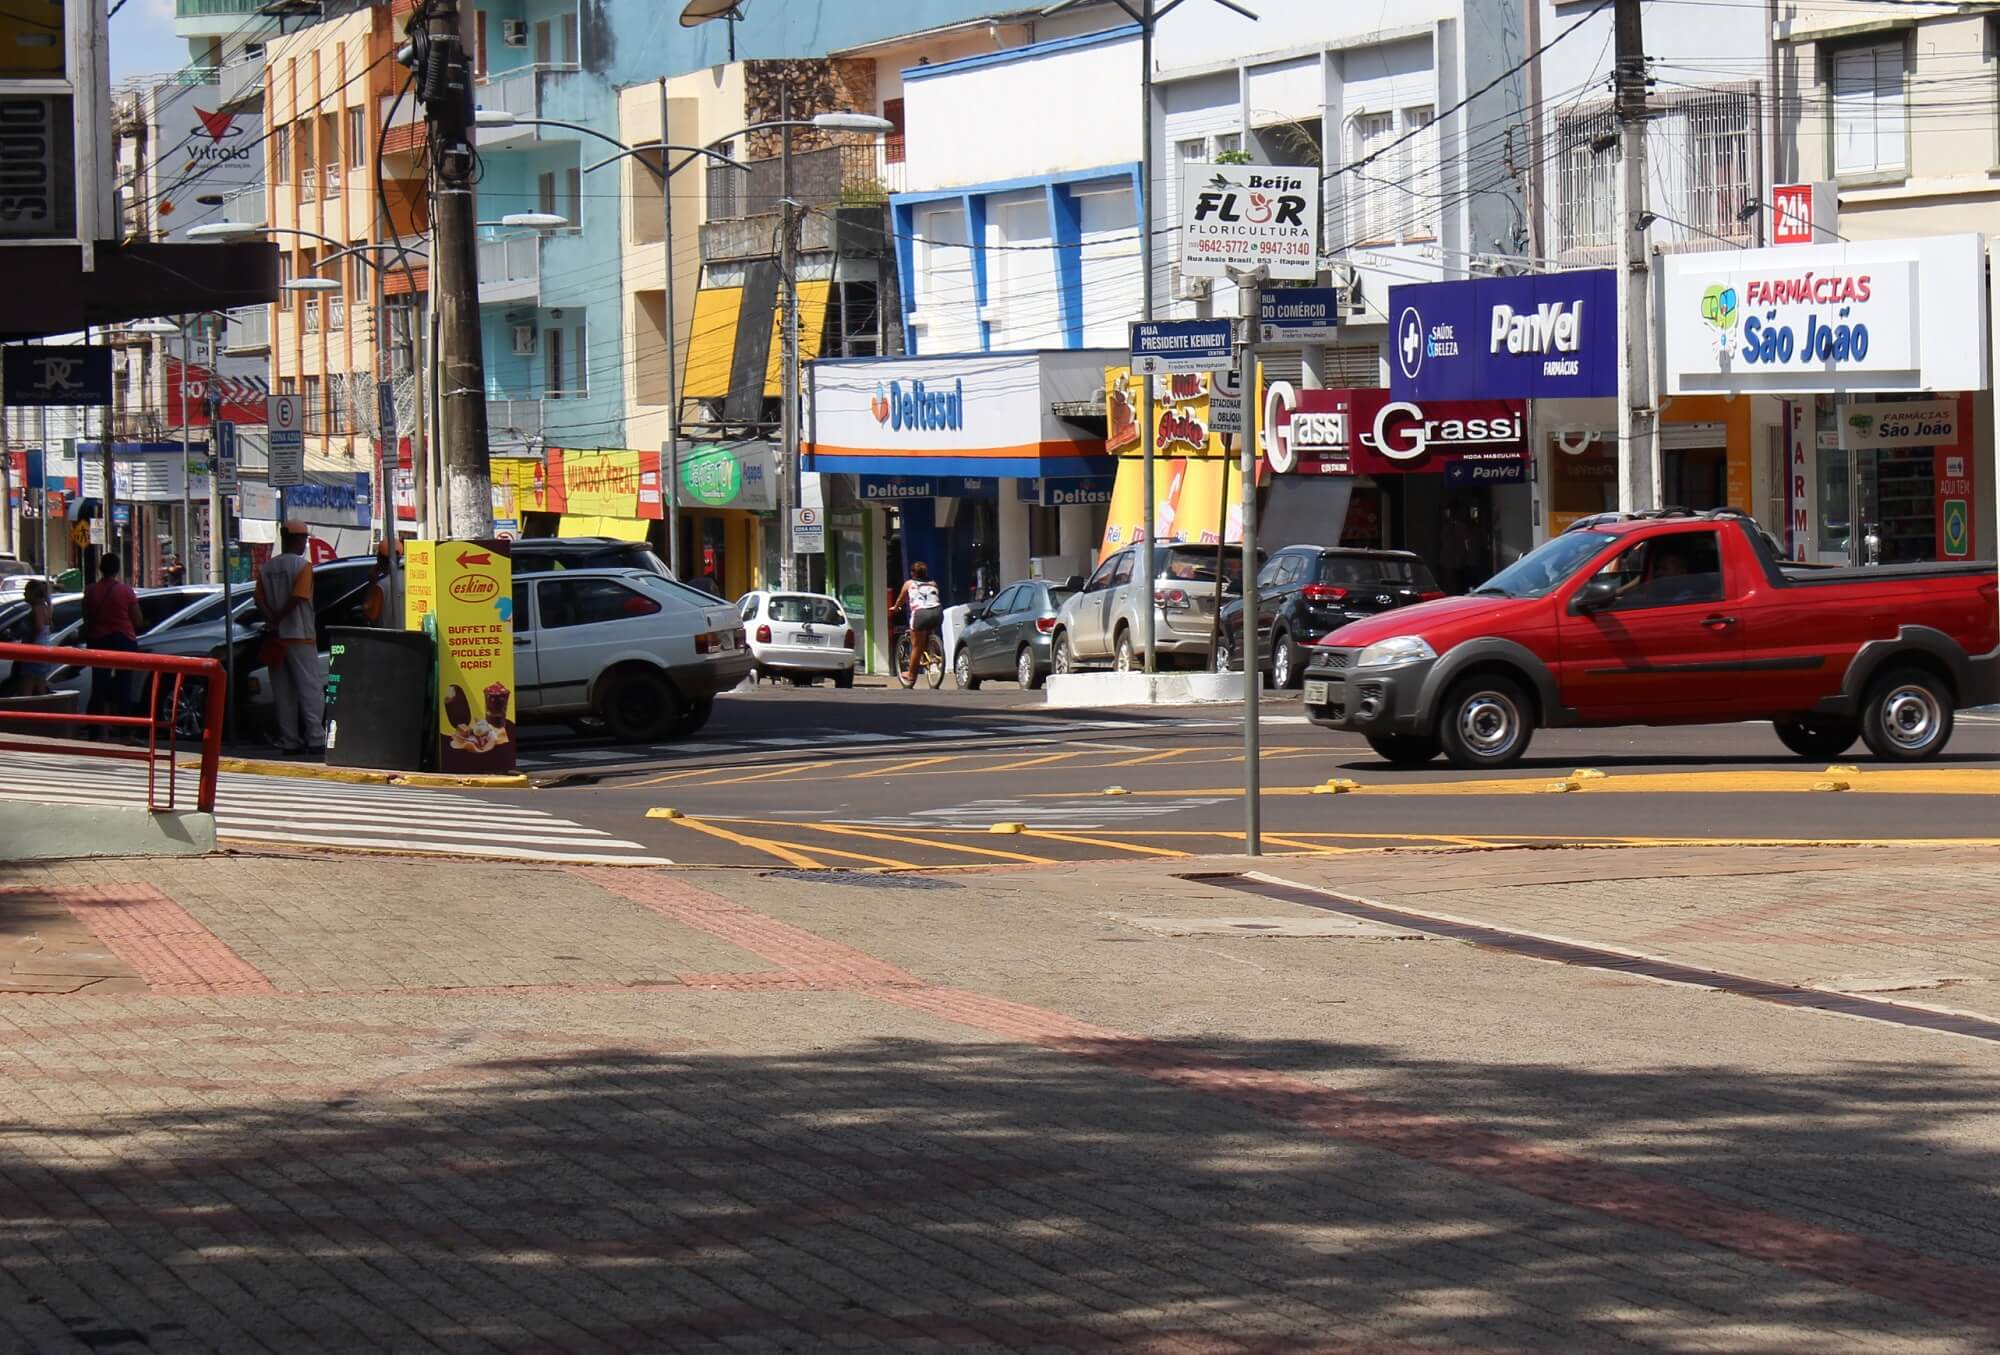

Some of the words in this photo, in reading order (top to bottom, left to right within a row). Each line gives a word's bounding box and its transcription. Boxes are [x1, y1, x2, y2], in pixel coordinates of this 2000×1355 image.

[187, 144, 249, 159] Vitrola
[1249, 175, 1301, 192] Beija
[1194, 192, 1306, 227] FLOR
[1776, 193, 1810, 237] 24h
[1190, 224, 1309, 237] FLORICULTURA
[1199, 239, 1248, 254] 9642-5772
[1260, 241, 1309, 256] 9947-3140
[1228, 256, 1254, 265] Brasil,
[1746, 272, 1871, 307] FARMÁCIAS
[1262, 294, 1276, 304] RUA
[1262, 305, 1275, 318] DO
[1277, 301, 1326, 318] COMÉRCIO
[1140, 325, 1158, 336] RUA
[1432, 323, 1454, 340] SAÚDE
[1490, 300, 1583, 355] PanVel
[1742, 308, 1794, 364] São
[1800, 306, 1869, 364] João
[1141, 334, 1189, 350] PRESIDENTE
[1190, 333, 1226, 348] KENNEDY
[1434, 341, 1459, 357] BELEZA
[1543, 358, 1579, 376] FARMÁCIAS
[890, 377, 963, 432] Deltasul
[1209, 398, 1240, 409] ESTACIONAM
[281, 404, 289, 421] E
[1883, 410, 1951, 421] FARMÁCIAS
[1262, 381, 1349, 474] Grassi
[1367, 402, 1521, 460] Grassi
[1879, 422, 1909, 438] São
[1914, 419, 1952, 436] João
[1483, 452, 1521, 460] MASCULINA
[568, 464, 600, 493] MUNDO
[1472, 466, 1521, 479] PanVel
[867, 483, 930, 497] Deltasul
[804, 512, 811, 521] E
[454, 575, 493, 594] eskimo
[448, 625, 485, 634] BUFFET
[490, 624, 503, 633] DE
[451, 646, 490, 657] PICOLÉS
[495, 648, 501, 657] E
